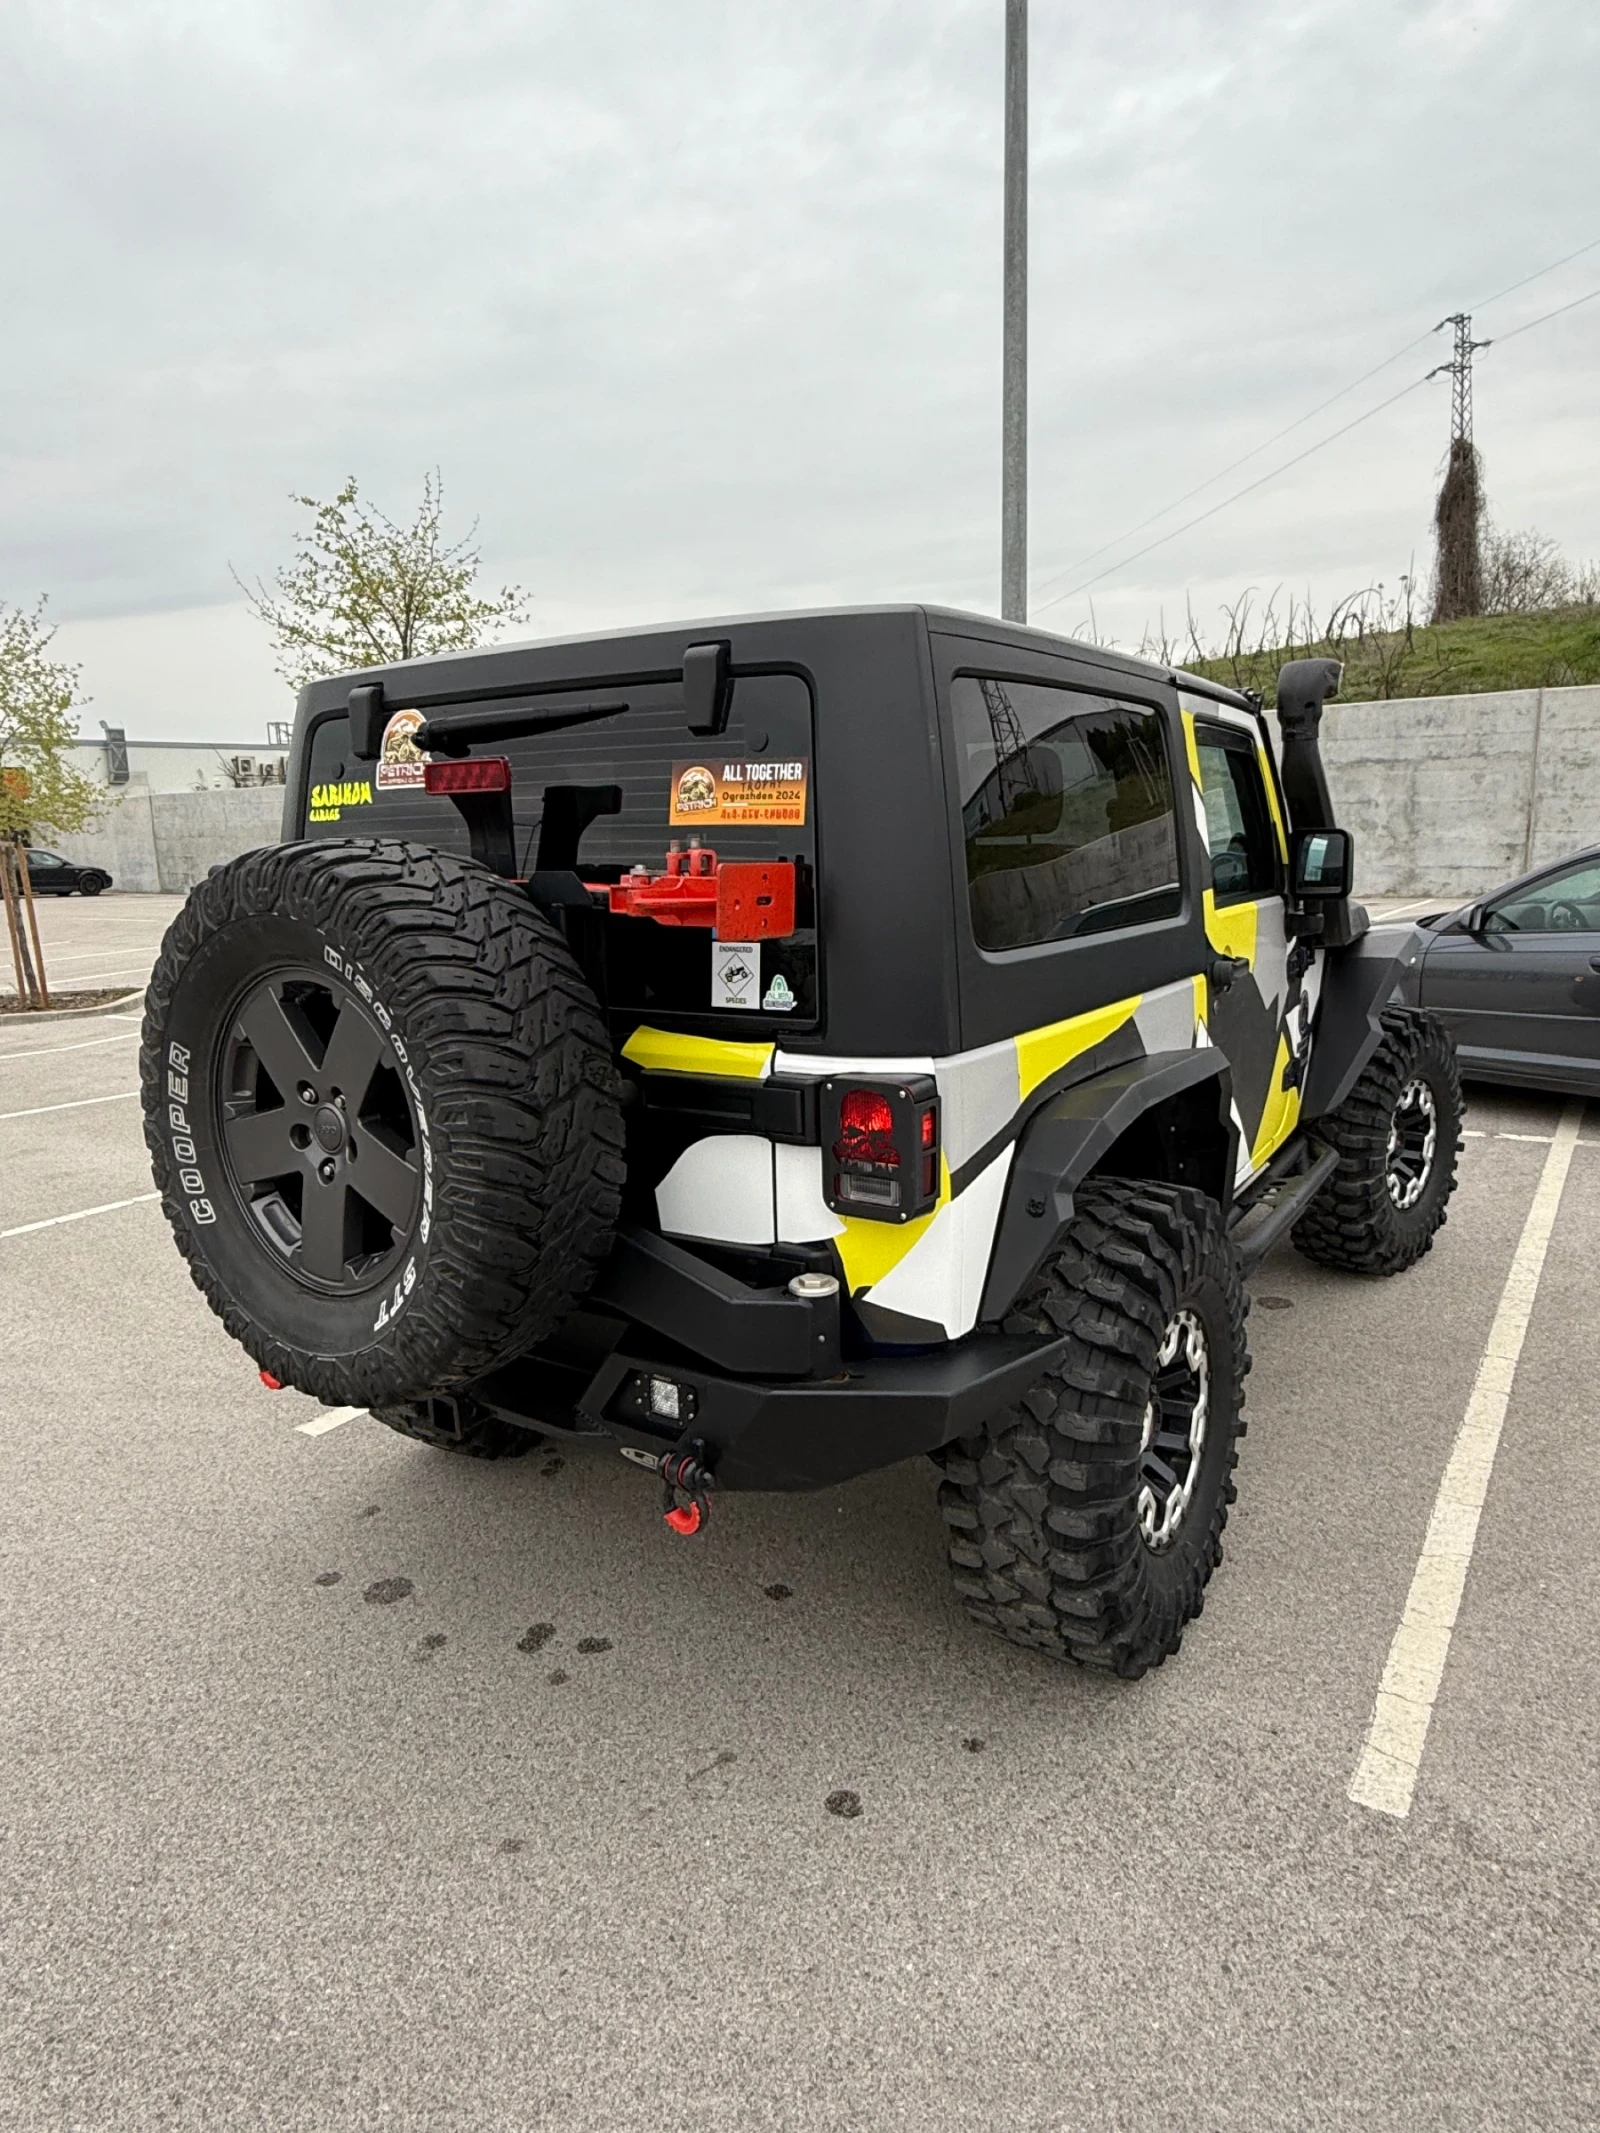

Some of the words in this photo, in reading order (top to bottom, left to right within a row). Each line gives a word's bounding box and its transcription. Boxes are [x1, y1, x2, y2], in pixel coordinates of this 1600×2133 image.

[722, 764, 743, 781] ALL
[745, 763, 803, 780] TOGETHER
[740, 780, 783, 793] TROPHY
[722, 791, 773, 803] Ograzhden
[775, 790, 801, 800] 2024
[719, 945, 754, 954] ENDANGERED
[725, 996, 747, 1005] SPECIES
[168, 1041, 216, 1224] COOPER
[373, 1256, 417, 1332] STT
